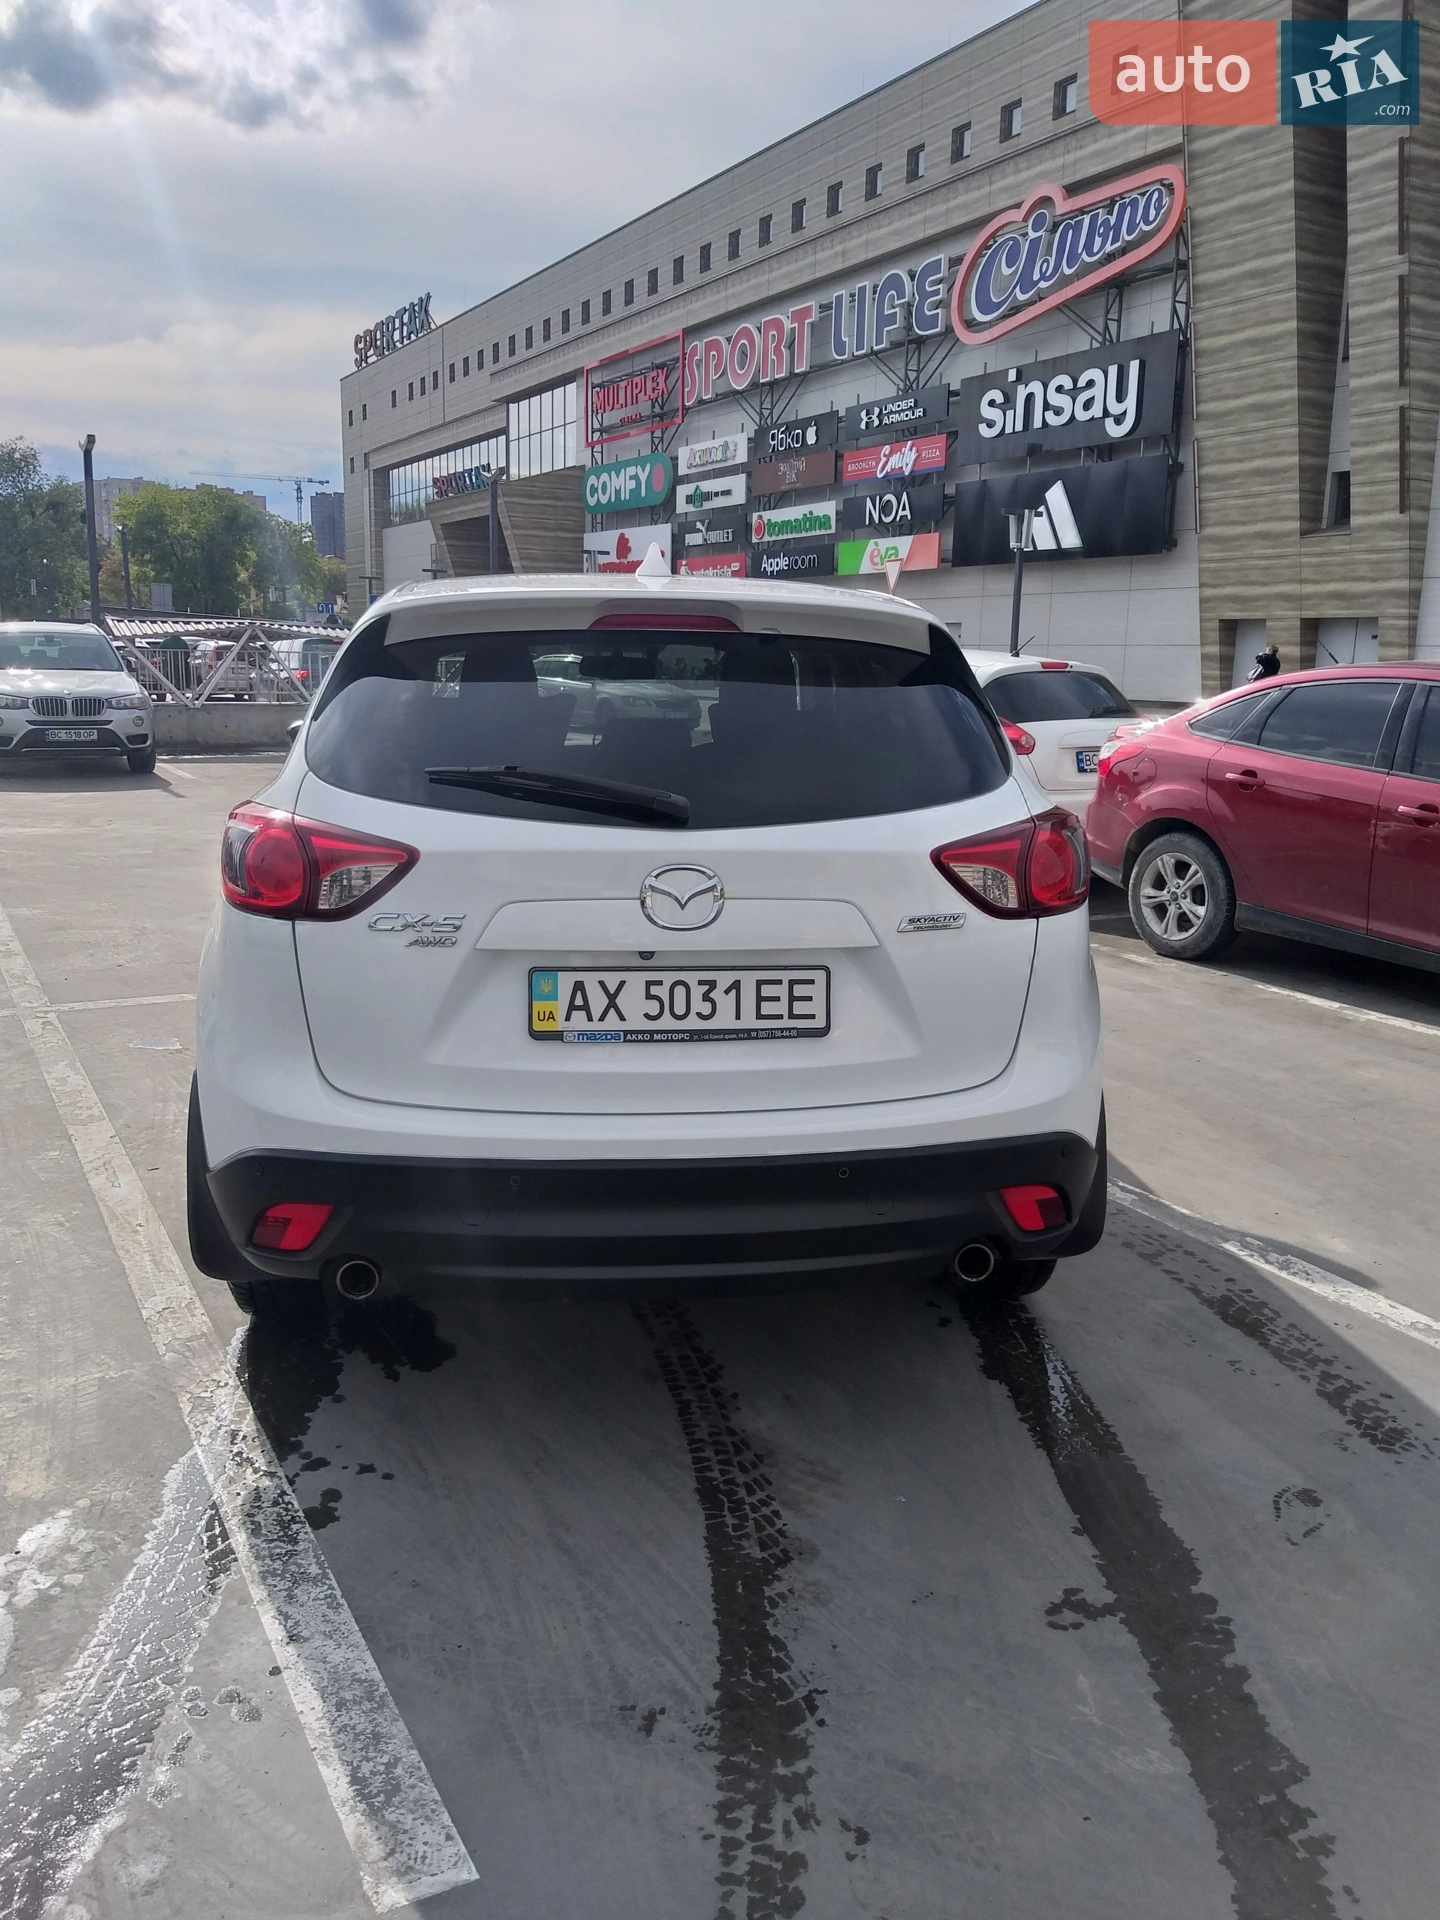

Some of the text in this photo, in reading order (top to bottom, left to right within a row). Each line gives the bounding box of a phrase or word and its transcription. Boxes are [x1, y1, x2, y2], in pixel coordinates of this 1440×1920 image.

[971, 184, 1170, 322] Сільпо
[354, 292, 431, 368] SPARTAK
[685, 254, 950, 406] SPORT LIFE
[593, 367, 670, 415] MULTIPLEX
[882, 398, 915, 414] UNDER
[978, 359, 1141, 438] sinsay
[882, 408, 923, 426] ARMOUR
[848, 440, 940, 478] BROOKLYN Emily PIZZA
[586, 463, 651, 507] COMFY
[766, 510, 832, 538] tomatina
[865, 491, 912, 526] NOA
[706, 529, 734, 544] OUTLET
[51, 731, 63, 739] BC
[64, 731, 82, 739] 1518
[368, 913, 466, 932] CX-5
[908, 914, 961, 924] SKYACTIV
[405, 936, 457, 947] AWD
[564, 978, 816, 1022] AX 5031 EE
[537, 1010, 556, 1022] UA
